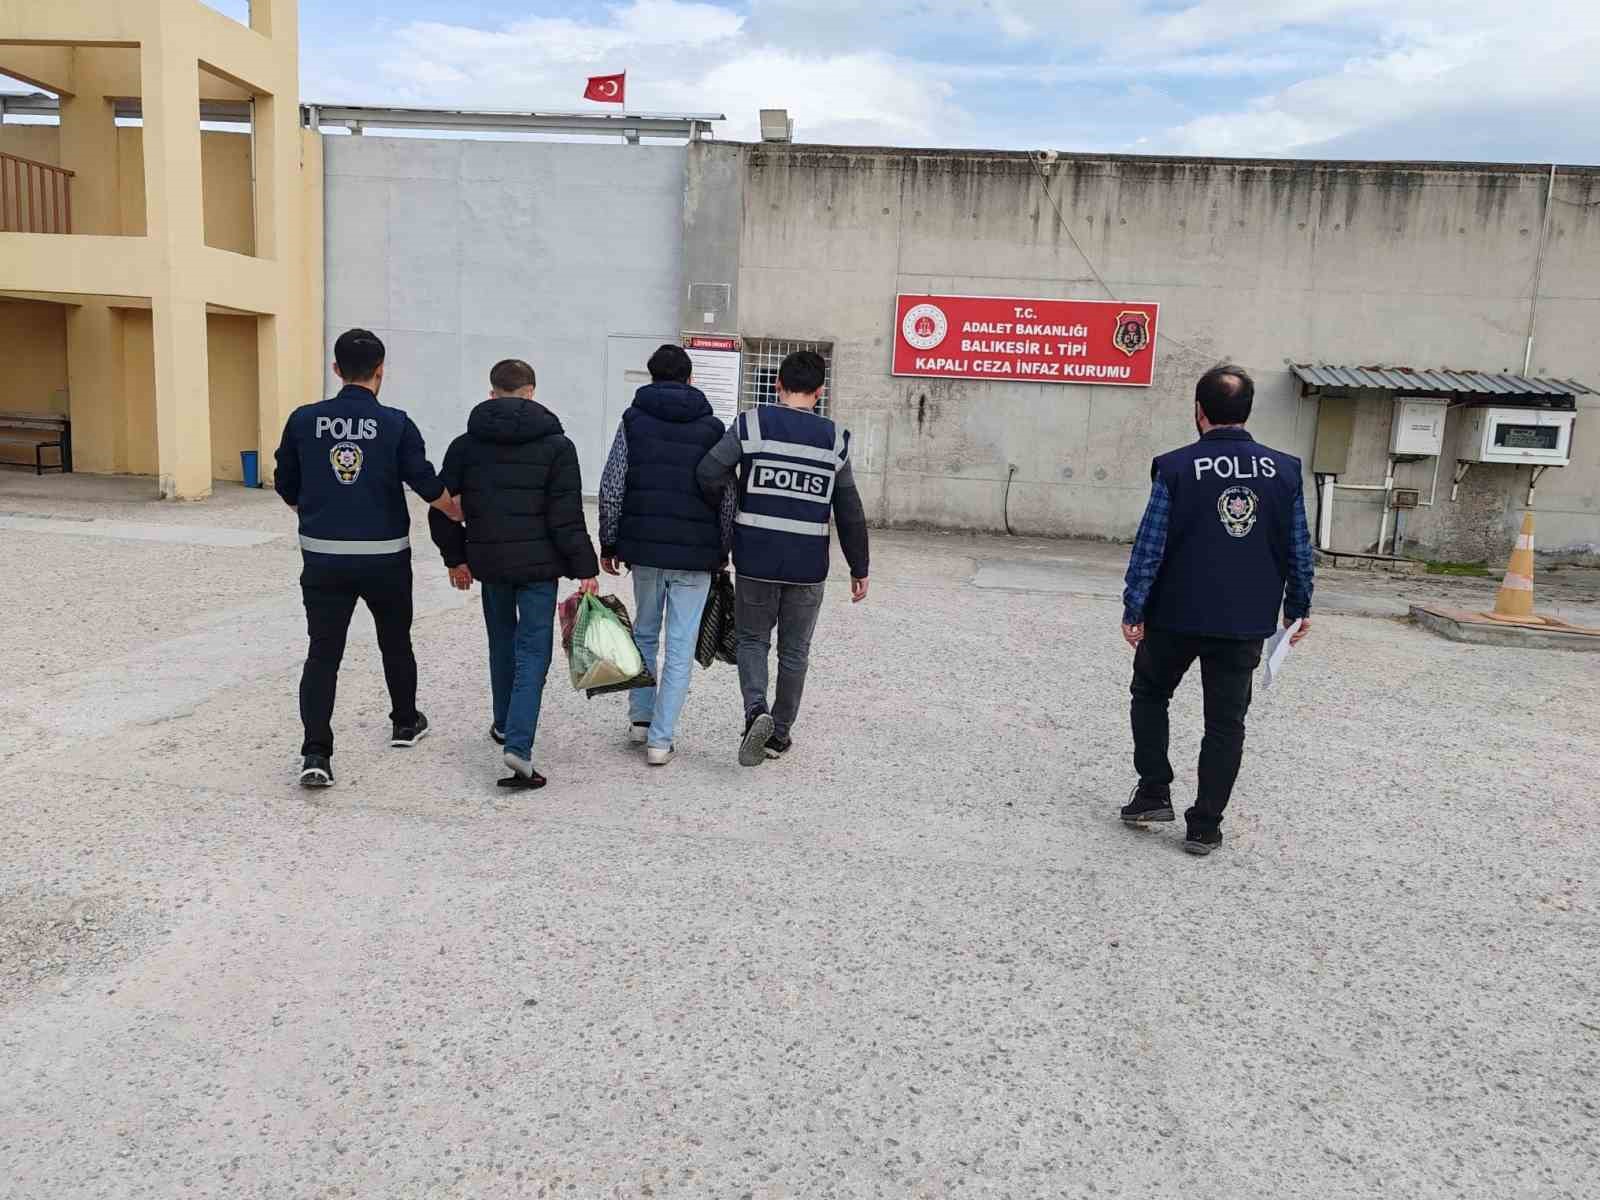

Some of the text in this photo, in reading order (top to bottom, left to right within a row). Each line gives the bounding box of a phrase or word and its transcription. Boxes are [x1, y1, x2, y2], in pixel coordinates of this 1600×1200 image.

[1014, 307, 1037, 319] T.C.
[962, 323, 1088, 337] ADALET BAKANLIĞI
[961, 338, 1087, 357] BALIKESİR L TİPİ
[916, 358, 1130, 378] KAPALI CEZA İNFAZ KURUMU
